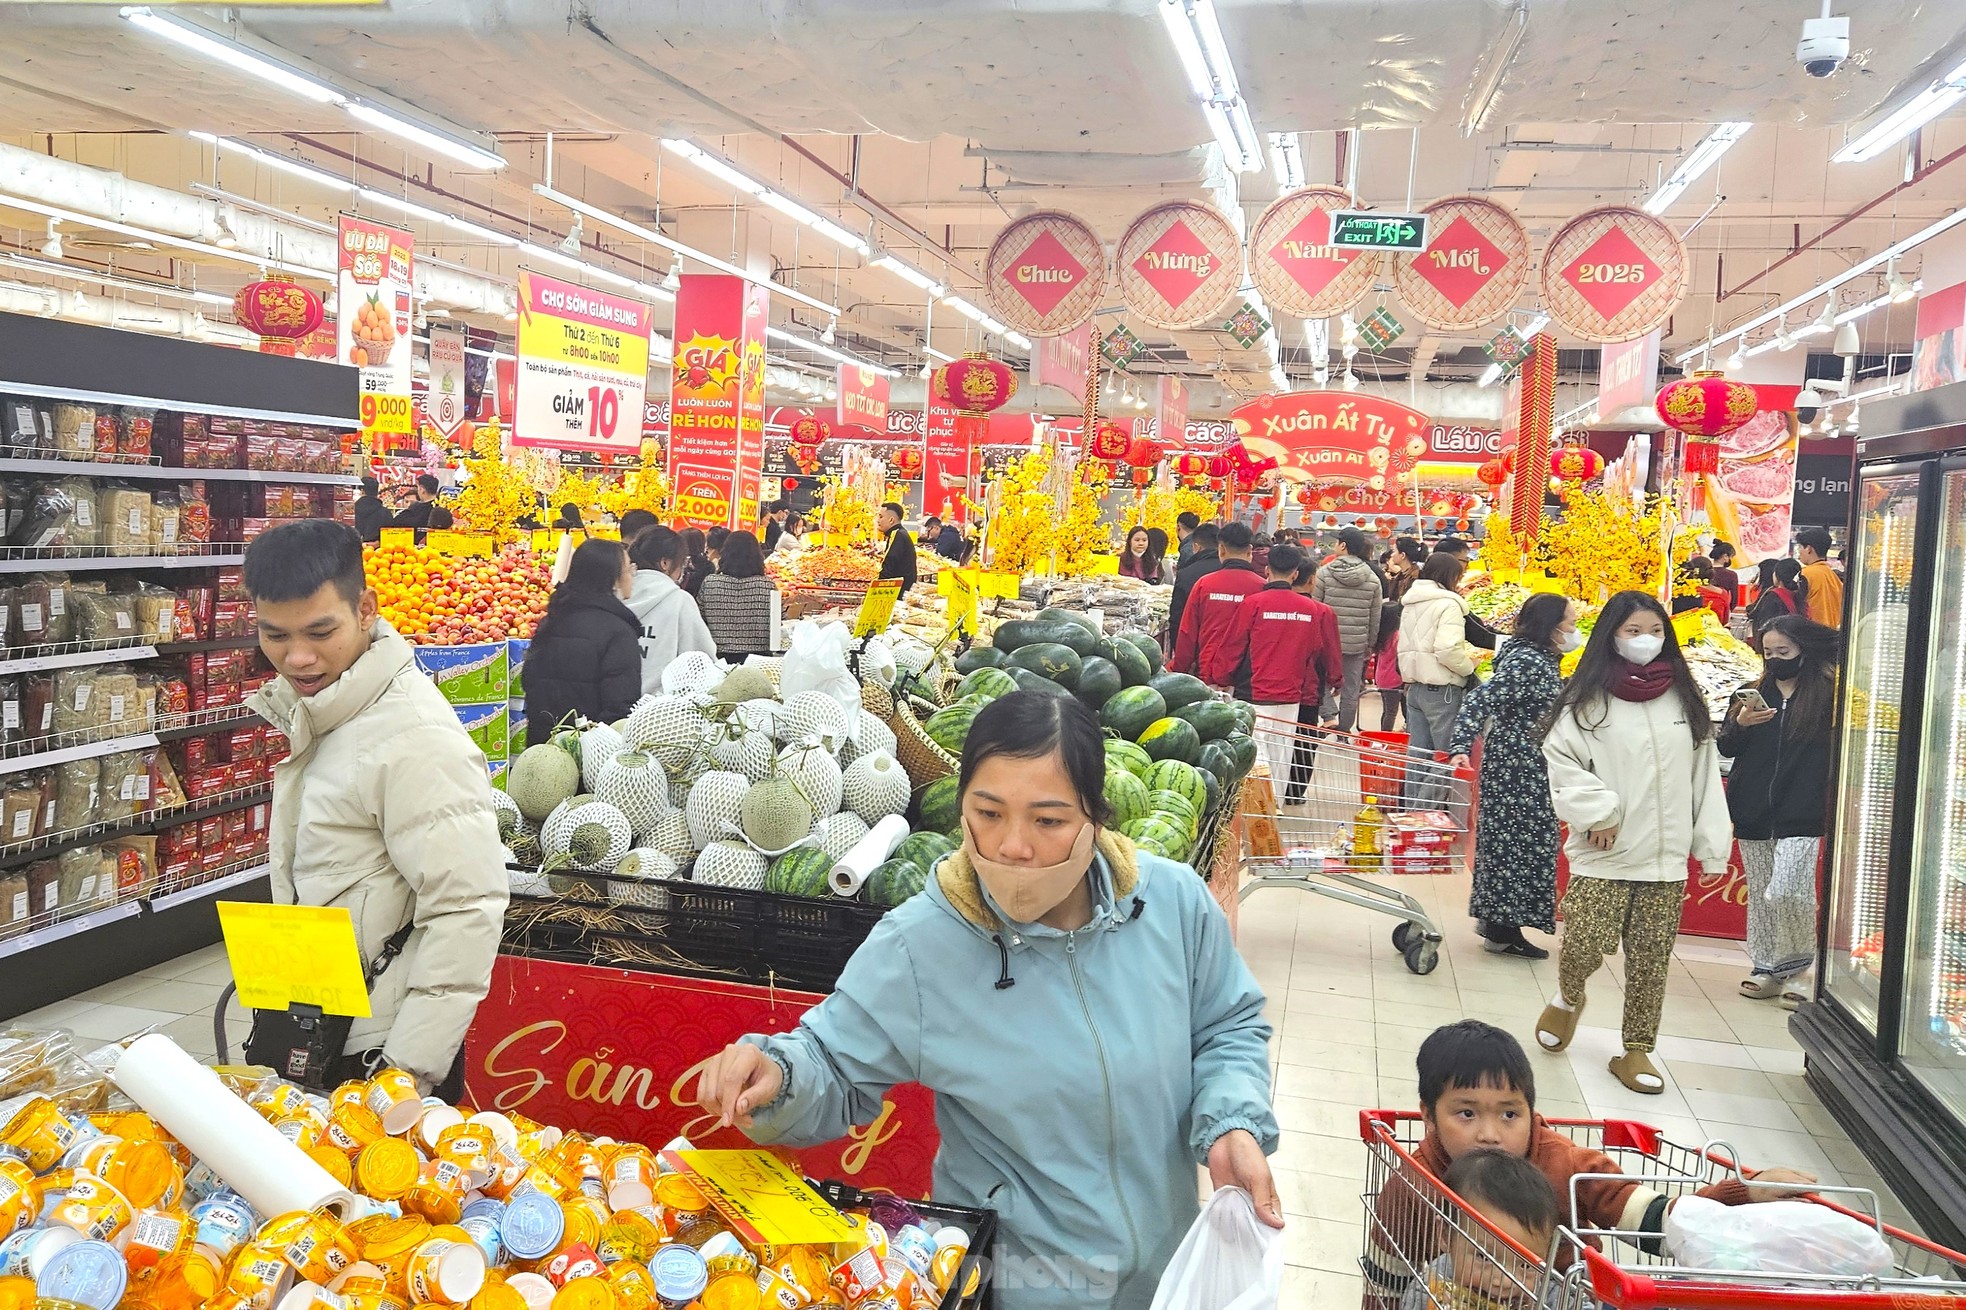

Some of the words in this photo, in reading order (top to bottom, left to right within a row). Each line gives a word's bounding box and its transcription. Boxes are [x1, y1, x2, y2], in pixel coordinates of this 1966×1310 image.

[344, 228, 366, 252] ƯU
[365, 230, 390, 254] ĐÃI
[1344, 233, 1373, 243] EXIT
[353, 252, 383, 279] SỐC
[1016, 260, 1073, 284] Chúc
[1143, 248, 1211, 278] Mừng
[1429, 247, 1490, 276] Mới
[1578, 264, 1644, 283] 2025
[541, 288, 565, 313] CHỢ
[588, 297, 613, 321] GIẢM
[614, 307, 638, 327] SUNG
[563, 325, 579, 340] Thứ
[580, 328, 586, 342] 2
[586, 331, 600, 345] đến
[600, 332, 615, 347] Thứ
[615, 337, 620, 349] 6
[569, 344, 589, 360] 8h00
[599, 349, 620, 365] 10h00
[685, 346, 731, 375] GIÁ
[525, 361, 539, 372] Toàn
[548, 364, 558, 374] sản
[558, 366, 572, 377] phẩm
[552, 389, 584, 416] GIẢM
[678, 397, 704, 407] LUÔN
[706, 398, 733, 408] LUÔN
[672, 408, 694, 428] RẺ
[697, 413, 737, 430] HƠN
[930, 406, 949, 416] Khu
[380, 417, 404, 429] vnd/kg
[565, 417, 582, 430] THÊM
[943, 417, 955, 428] tự
[1263, 409, 1327, 436] Xuân
[1333, 402, 1360, 433] Ất
[1365, 413, 1395, 446] Tỵ
[930, 426, 953, 437] phục
[1432, 425, 1483, 453] Lẩu
[682, 437, 696, 445] Tiết
[696, 437, 714, 447] kiệm
[714, 439, 728, 447] hơn
[688, 447, 704, 455] ngày
[705, 448, 722, 456] cùng
[696, 470, 712, 478] THÊM
[692, 487, 717, 499] TRÊN
[678, 498, 727, 518] 2.000
[740, 501, 757, 518] 2.000
[1209, 592, 1234, 601] KARATEDO
[1263, 611, 1287, 621] KARATEDO
[1287, 610, 1297, 621] QUẾ
[1297, 613, 1312, 623] PHONG
[420, 648, 438, 657] Apples
[438, 648, 452, 656] from
[452, 648, 471, 656] France
[448, 664, 469, 680] Valley
[470, 646, 504, 672] Orchards
[450, 694, 475, 704] Pommes
[486, 693, 505, 702] France
[468, 705, 503, 730] Orchards
[484, 1019, 660, 1111] Sẵn
